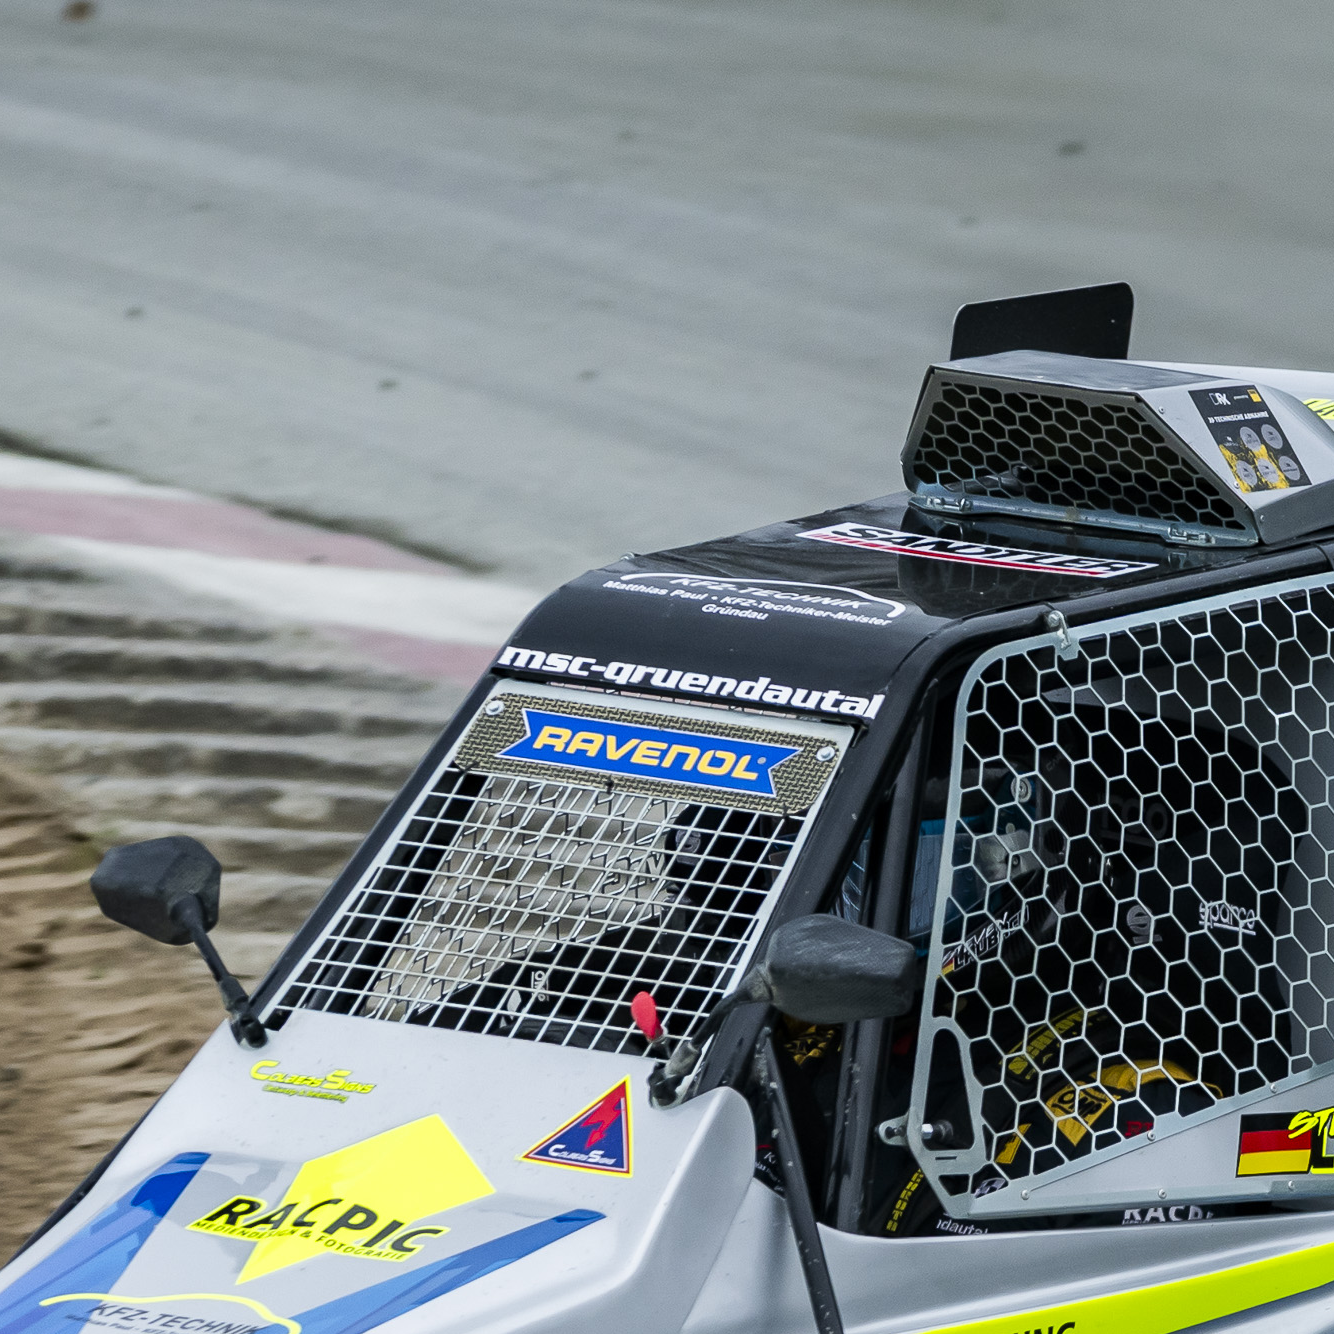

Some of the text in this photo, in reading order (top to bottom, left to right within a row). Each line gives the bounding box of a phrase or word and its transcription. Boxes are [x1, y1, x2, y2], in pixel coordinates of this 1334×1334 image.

[602, 580, 669, 597] Matthias
[669, 588, 708, 601] Paul
[669, 577, 872, 609] KFZ-TECHNIK
[701, 602, 769, 621] Gründau
[497, 645, 886, 720] msc-gruendautal
[532, 724, 762, 781] RAVENOL
[1199, 901, 1255, 930] sparco
[193, 1220, 296, 1240] MEDIENDESIGN
[315, 1234, 407, 1261] FOTOGRAFIE
[204, 1197, 444, 1253] RACPIC
